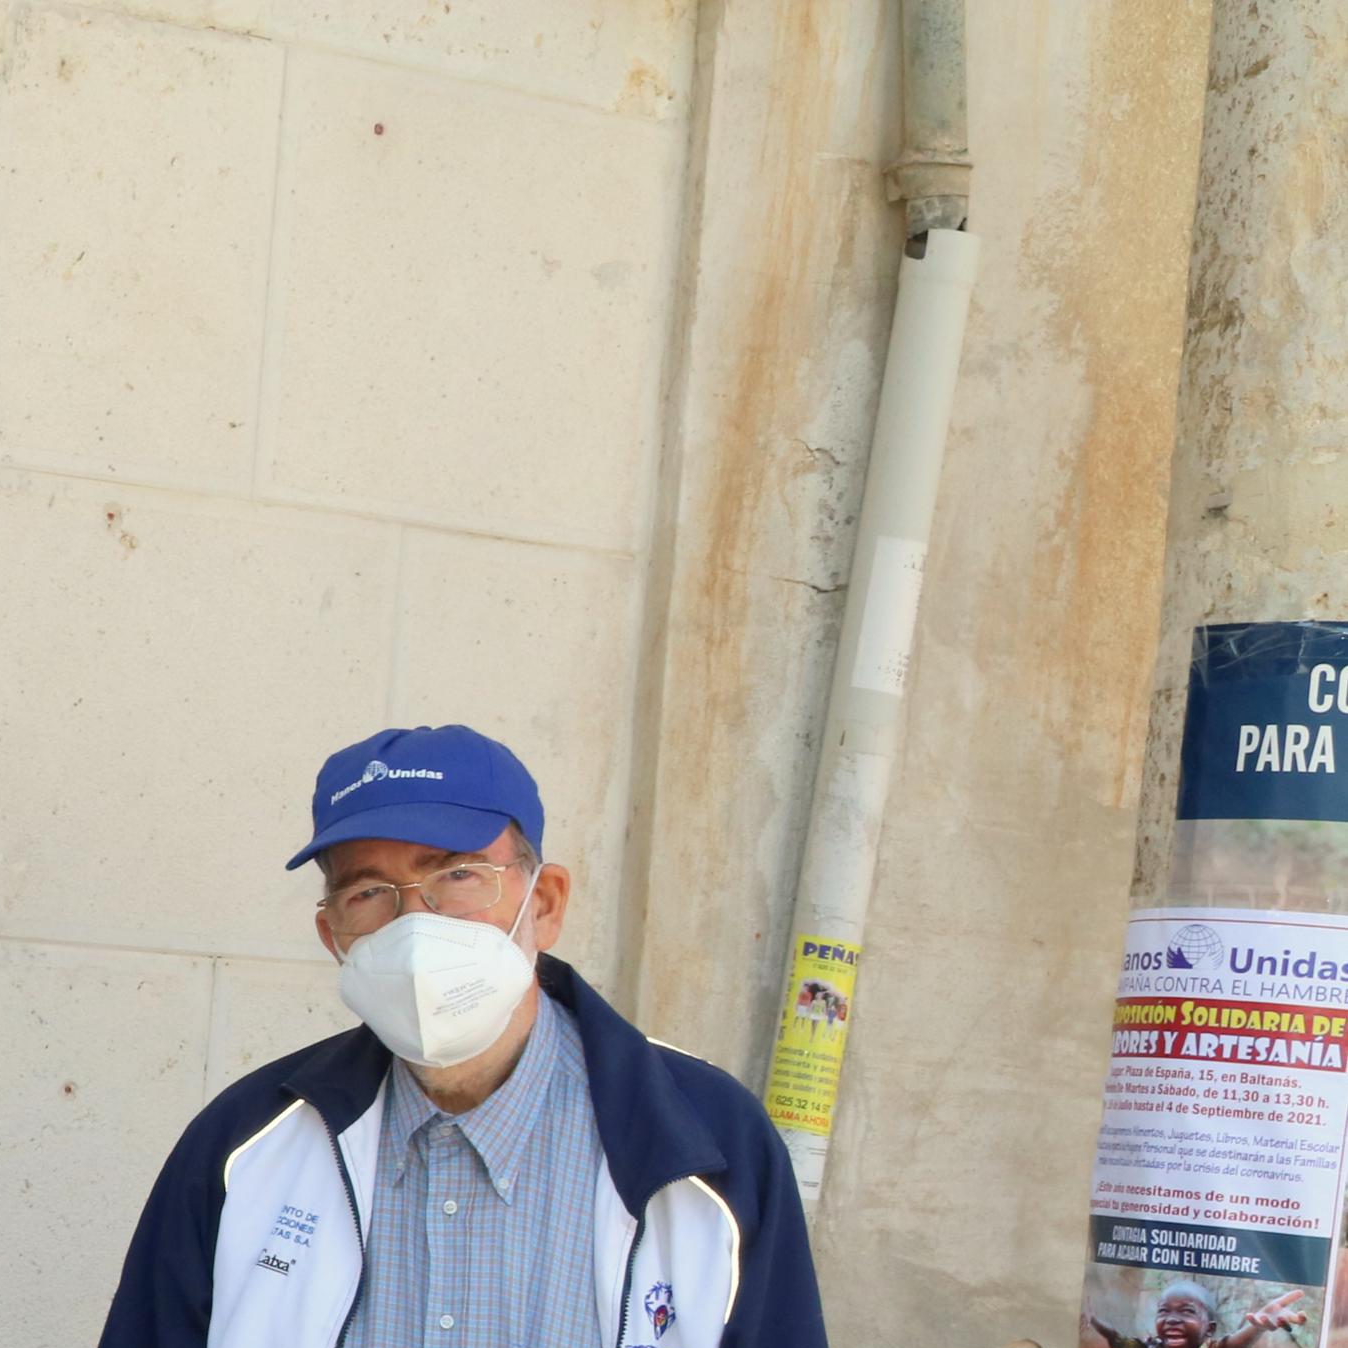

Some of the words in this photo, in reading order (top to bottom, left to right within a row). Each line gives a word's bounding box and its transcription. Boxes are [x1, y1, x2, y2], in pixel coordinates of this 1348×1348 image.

[1235, 724, 1336, 773] PARA
[331, 780, 362, 805] Manos
[389, 769, 443, 780] Unidas
[1154, 976, 1223, 993] CONTRA
[1231, 980, 1251, 996] EL
[1312, 1016, 1344, 1037] DE
[1163, 1033, 1177, 1055] Y
[1183, 1033, 1342, 1069] ARTESANÍA
[1221, 1073, 1236, 1083] en
[1240, 1073, 1301, 1089] Baltanás.
[1158, 1084, 1199, 1098] Sábado,
[1203, 1088, 1218, 1099] de
[1223, 1090, 1259, 1102] 11,30
[1262, 1094, 1269, 1103] a
[1274, 1093, 1313, 1108] 13,30
[1166, 1102, 1173, 1112] 4
[1175, 1104, 1189, 1114] de
[1192, 1104, 1265, 1122] Septiembre
[1268, 1111, 1283, 1122] de
[1287, 1111, 1327, 1126] 2021.
[1253, 1136, 1298, 1150] Material
[1300, 1140, 1339, 1153] Escolar
[1193, 1162, 1220, 1174] crisis
[1223, 1163, 1239, 1176] del
[1241, 1166, 1304, 1182] coronavirus.
[1294, 1156, 1337, 1169] Familias
[1127, 1184, 1201, 1201] necesitamos
[1206, 1189, 1224, 1202] de
[1230, 1194, 1250, 1204] un
[1255, 1195, 1301, 1210] modo
[1121, 1200, 1189, 1217] generosidad
[1204, 1206, 1319, 1229] colaboración!
[1151, 1229, 1236, 1252] SOLIDARIDAD
[1098, 1242, 1115, 1258] PARA
[1151, 1247, 1179, 1265] CON
[1183, 1251, 1198, 1267] EL
[1201, 1253, 1260, 1274] HAMBRE
